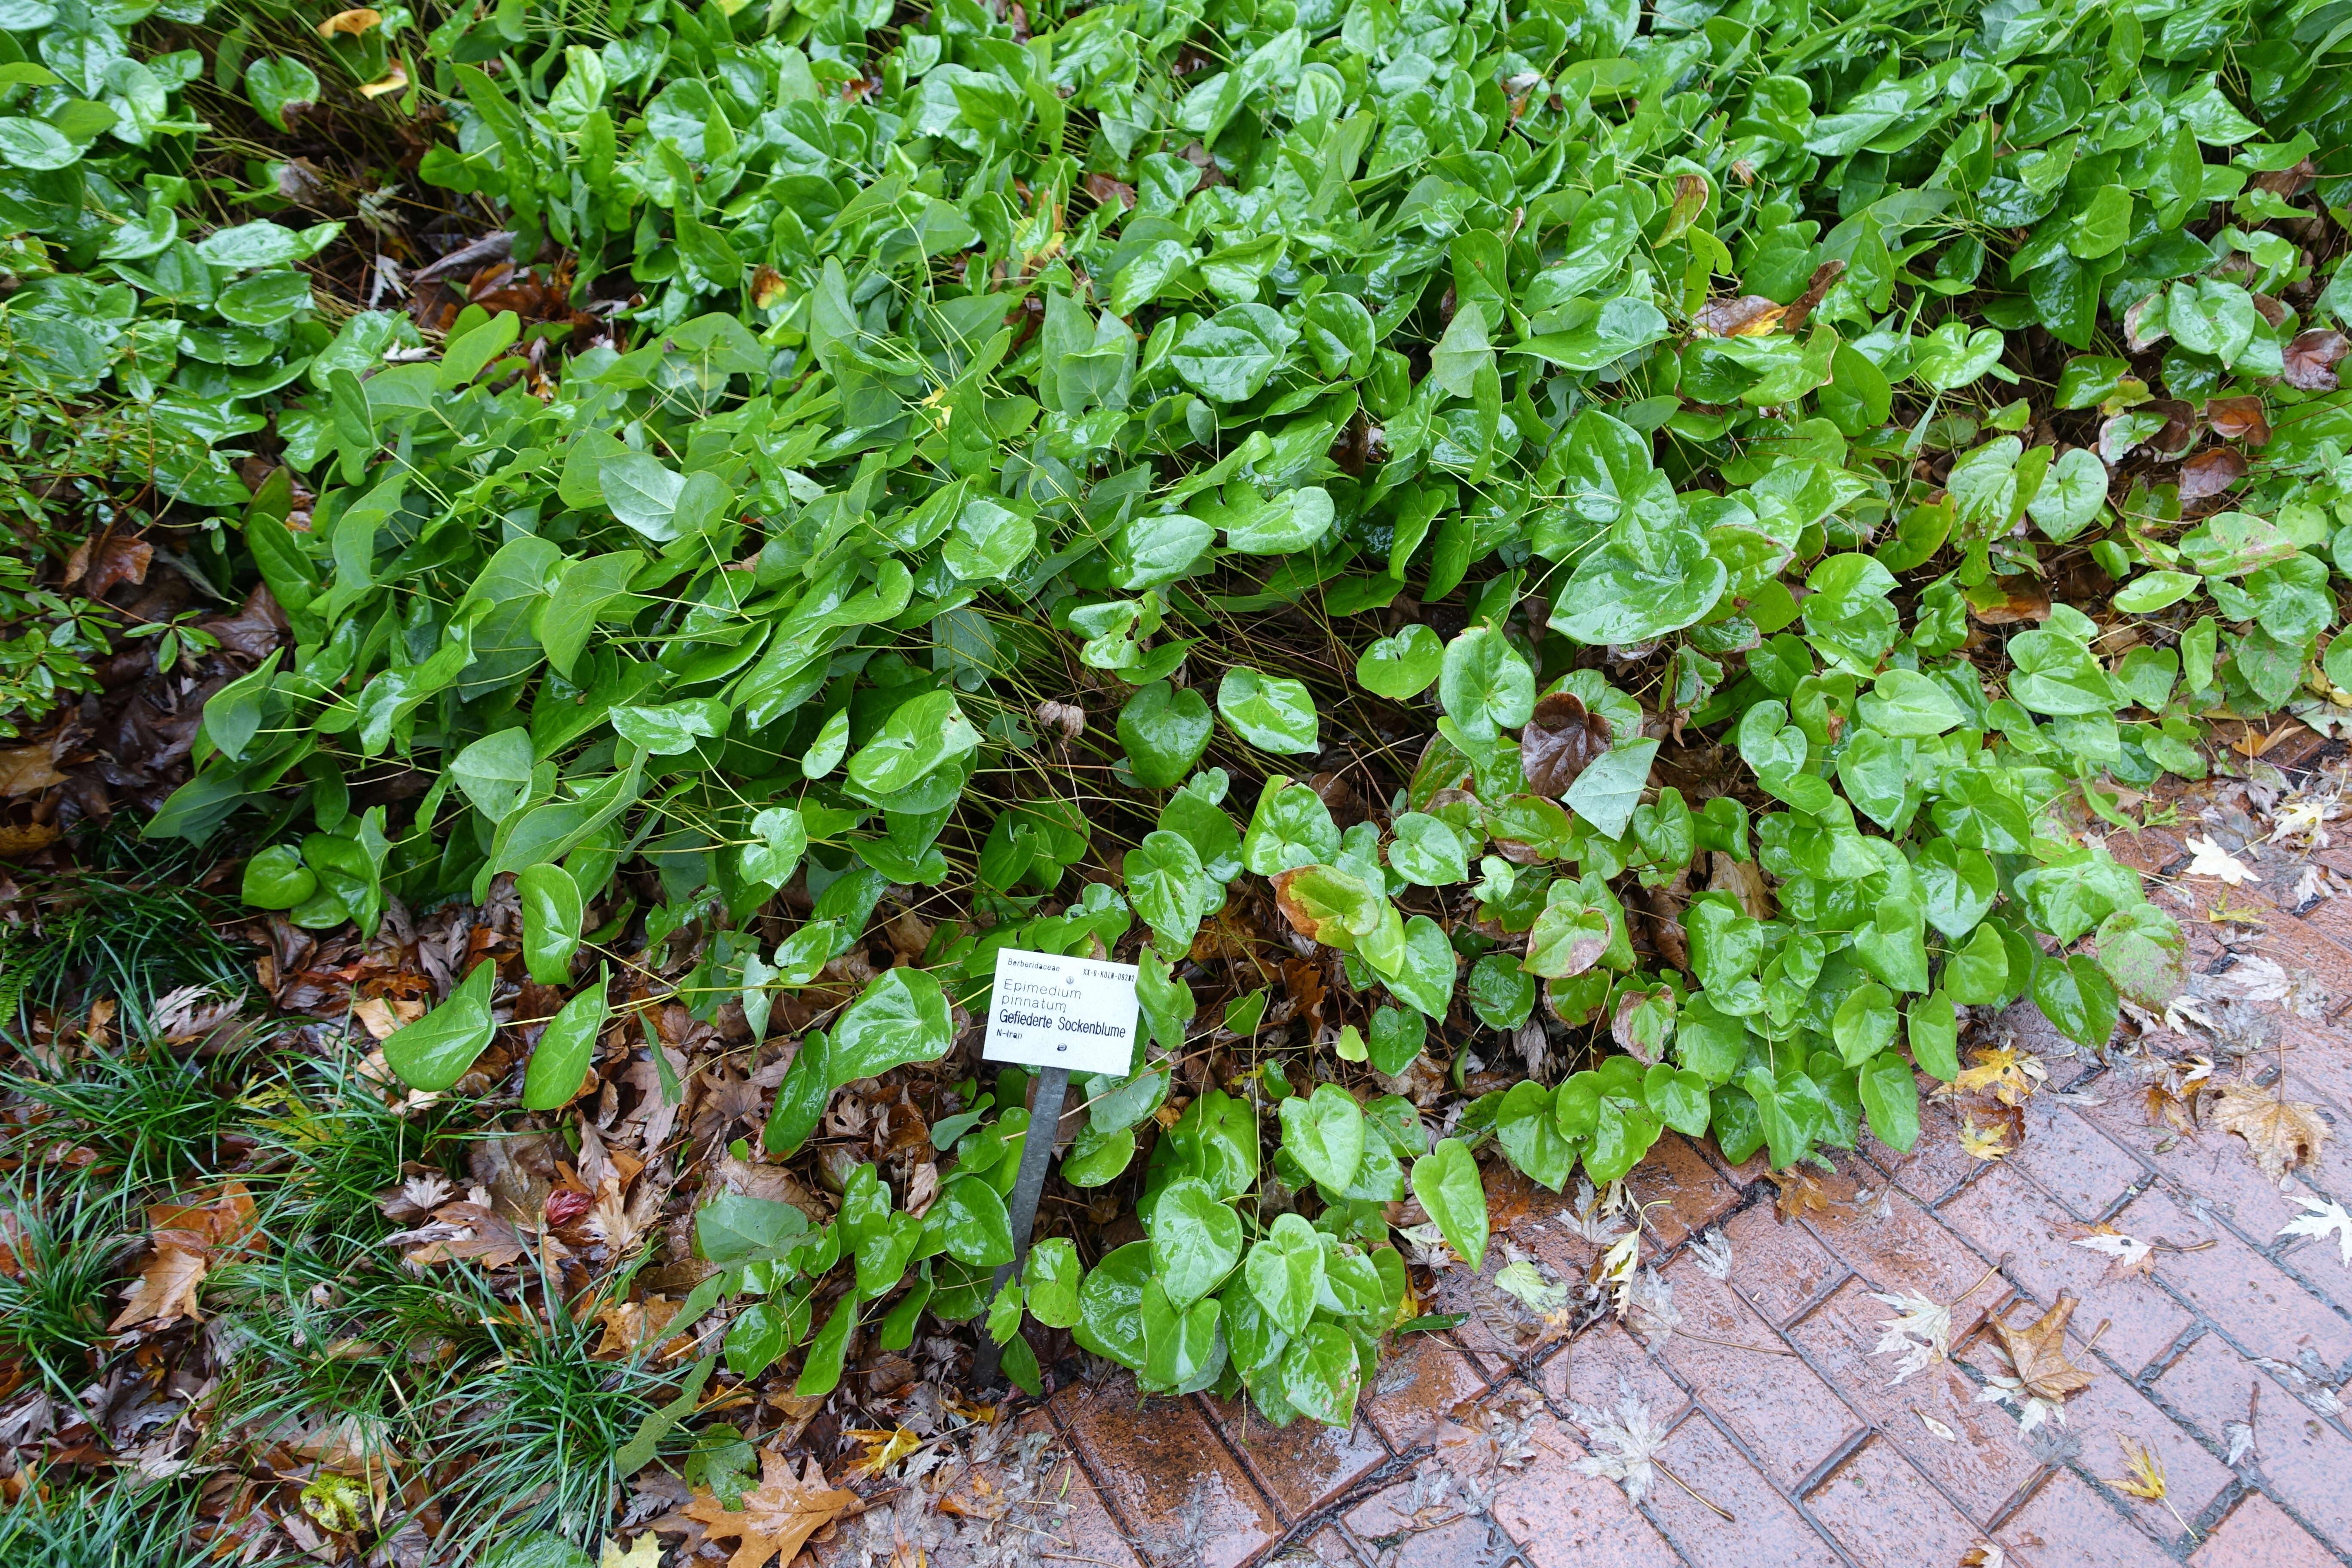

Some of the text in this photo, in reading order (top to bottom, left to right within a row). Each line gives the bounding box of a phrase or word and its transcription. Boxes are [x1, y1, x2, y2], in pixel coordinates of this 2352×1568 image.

[1008, 958, 1060, 971] Berberidaceae
[1004, 979, 1081, 999] Epimedium
[1002, 995, 1066, 1013] pinnatum
[1000, 1009, 1126, 1038] Gefiederte Sockenblume
[996, 1029, 1022, 1039] N-Iran
